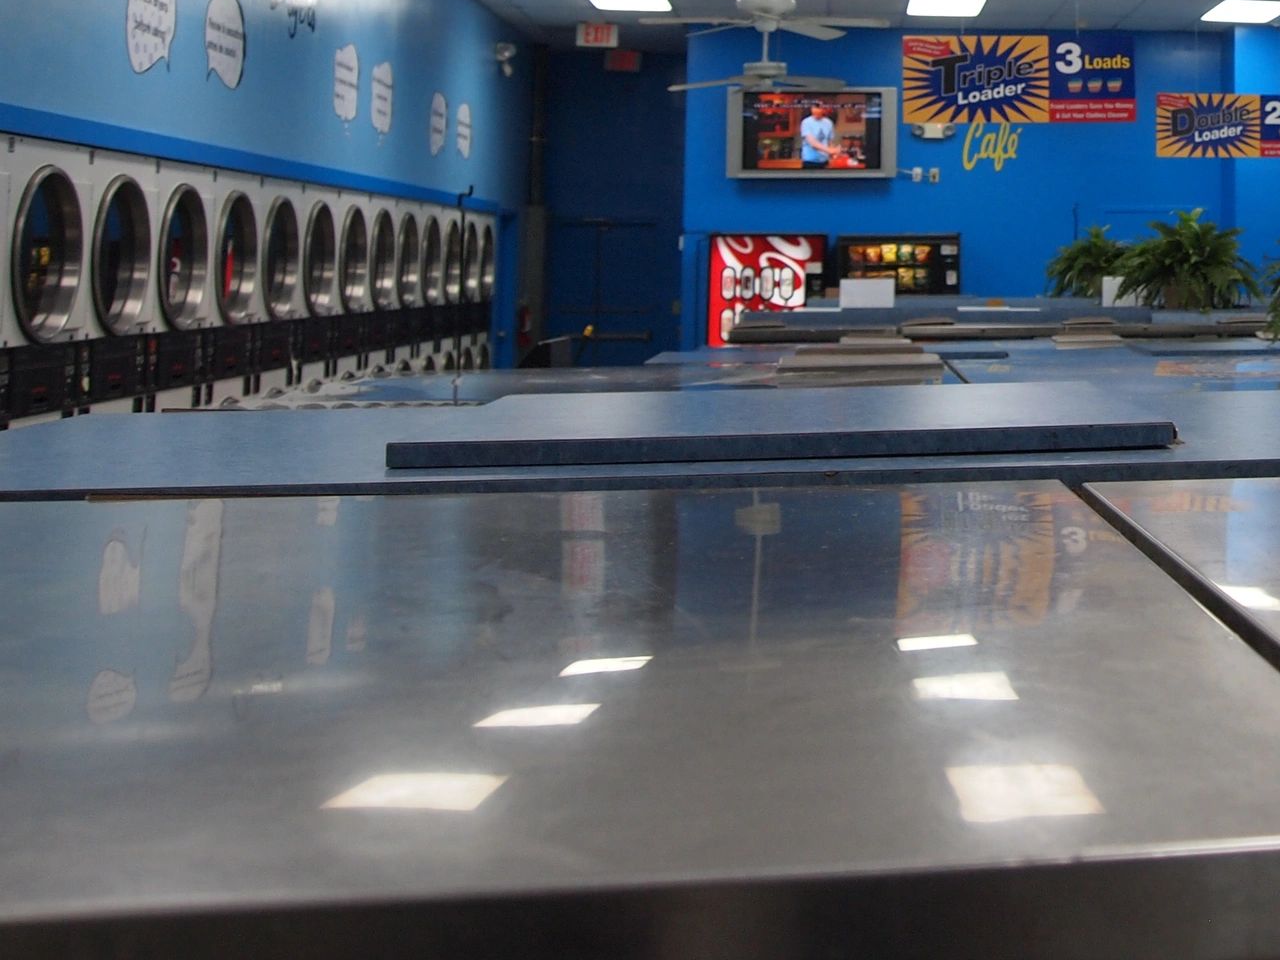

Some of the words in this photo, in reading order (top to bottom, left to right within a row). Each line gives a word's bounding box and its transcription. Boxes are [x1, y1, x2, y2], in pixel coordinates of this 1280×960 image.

[930, 52, 1035, 97] Triple
[1055, 42, 1083, 75] 3
[1084, 54, 1131, 70] Loads
[957, 82, 1026, 106] Loader
[1171, 106, 1251, 138] Double
[1194, 125, 1243, 143] Loader
[963, 121, 1023, 172] Café
